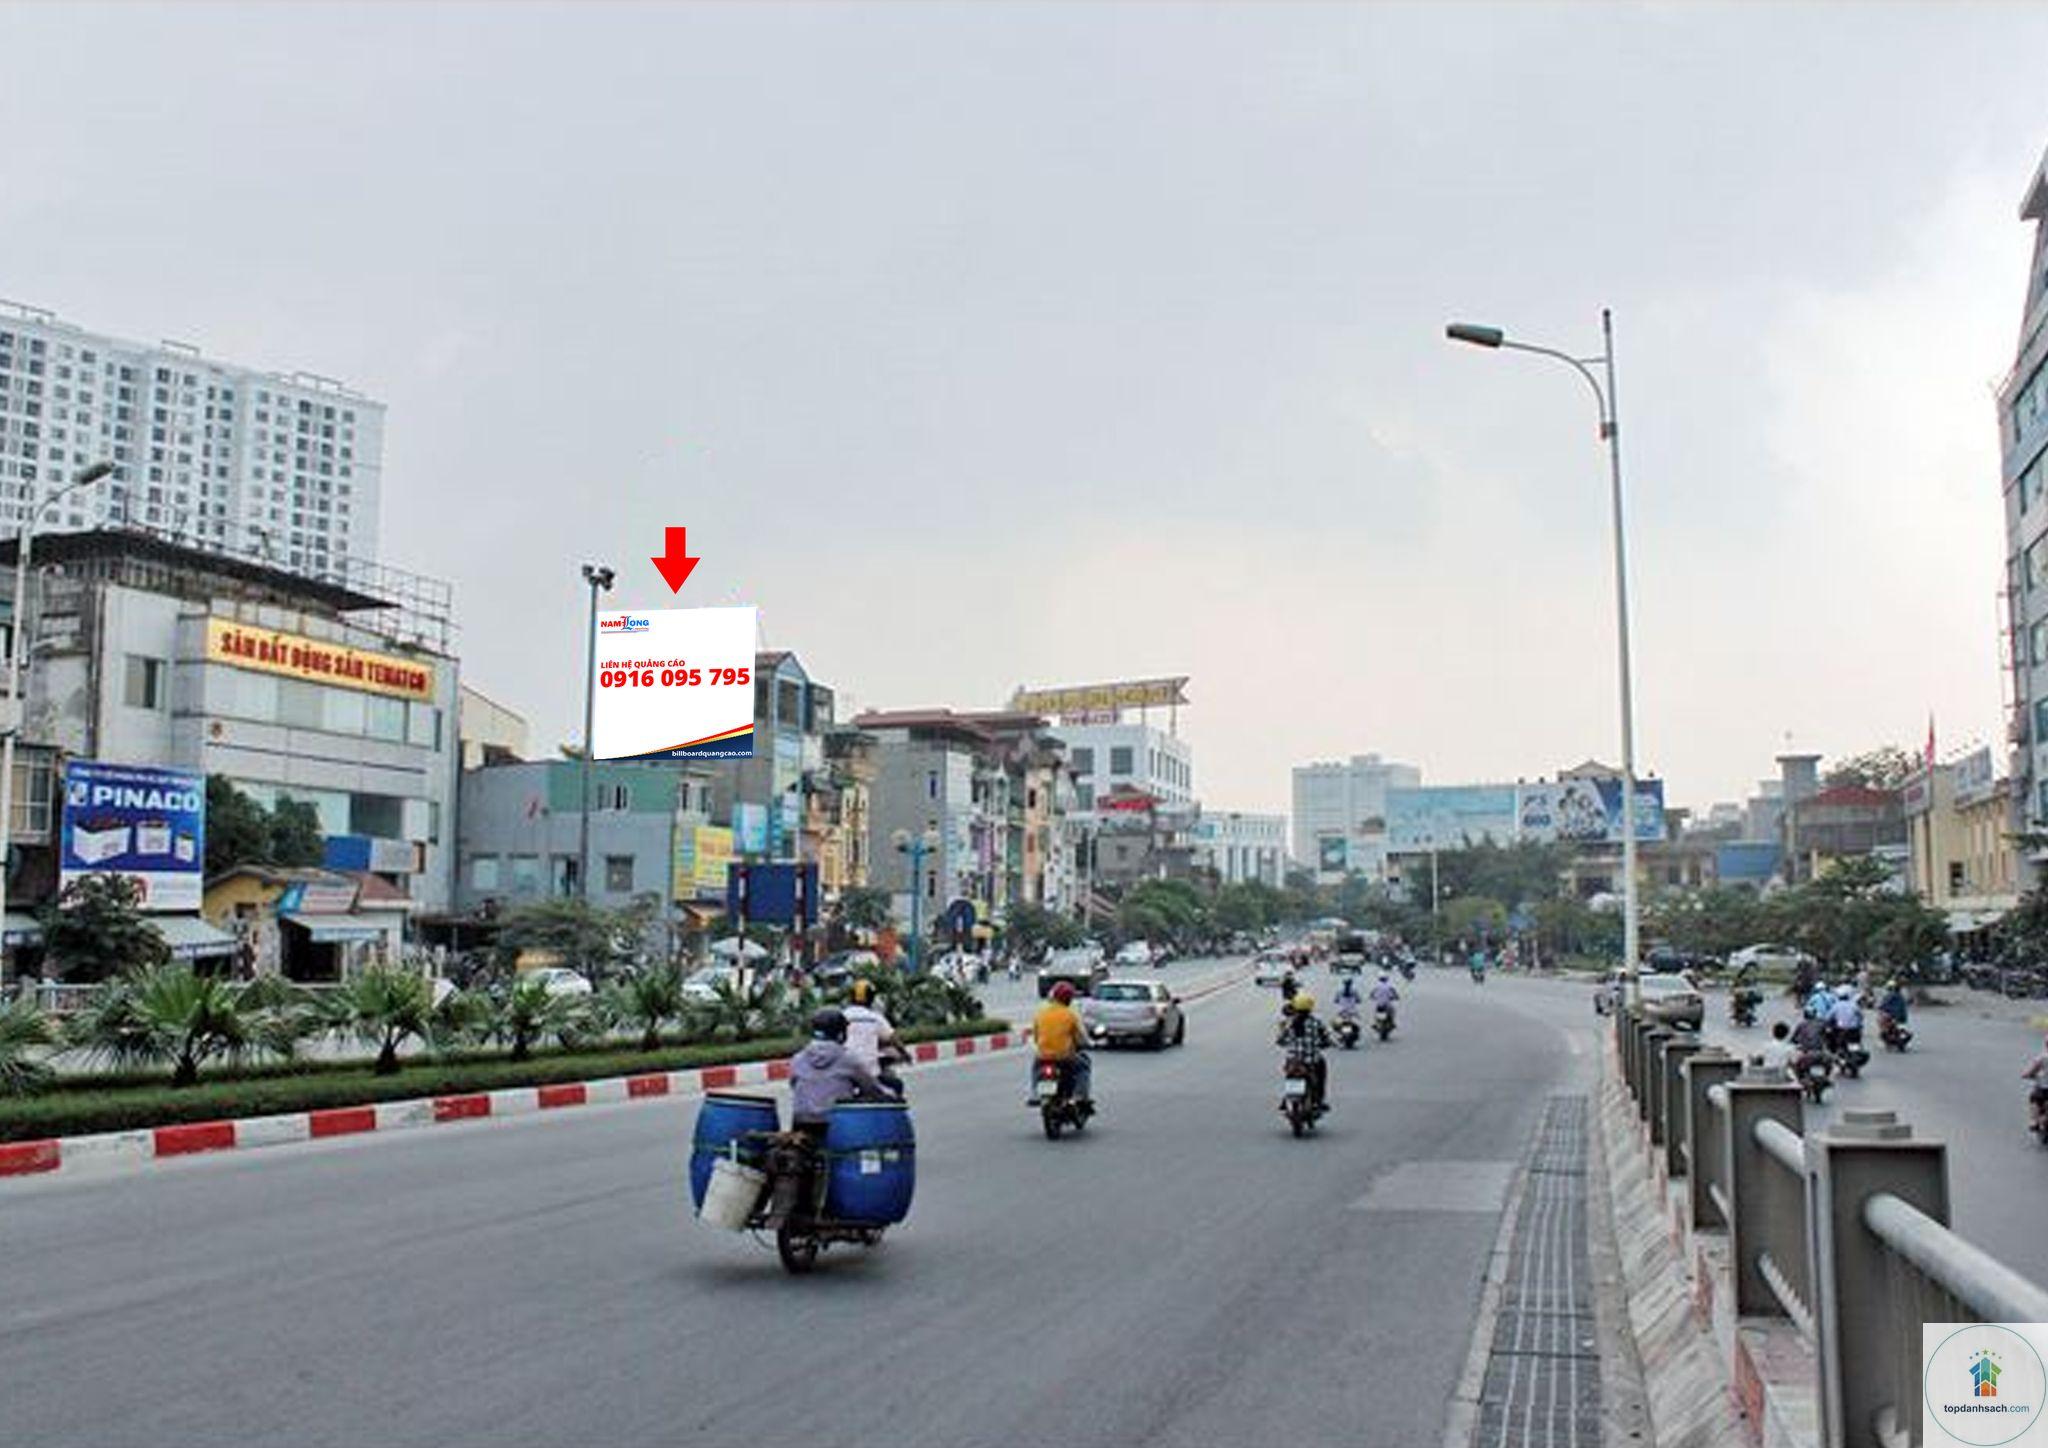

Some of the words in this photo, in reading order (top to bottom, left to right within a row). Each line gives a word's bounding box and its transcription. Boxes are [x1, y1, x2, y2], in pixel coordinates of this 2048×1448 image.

[667, 659, 685, 667] CÁO
[600, 669, 655, 688] 0916
[661, 669, 701, 687] 095
[709, 668, 750, 686] 795
[93, 785, 200, 812] PINACO
